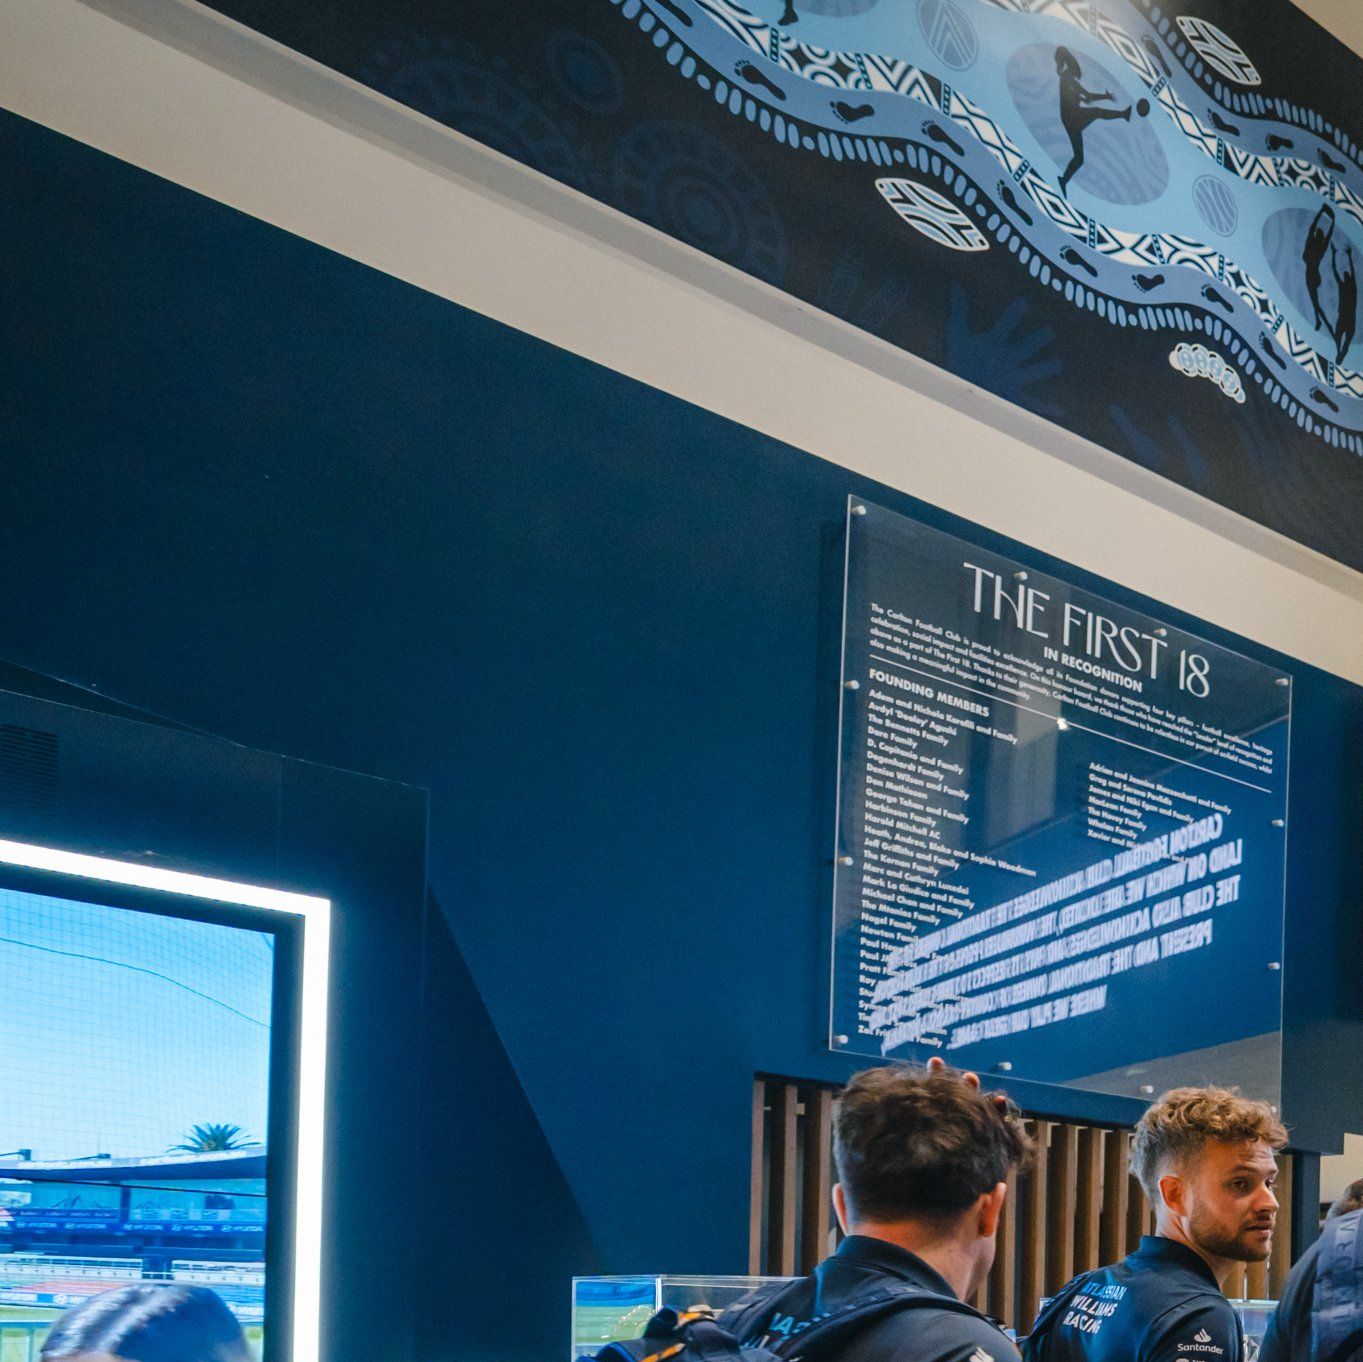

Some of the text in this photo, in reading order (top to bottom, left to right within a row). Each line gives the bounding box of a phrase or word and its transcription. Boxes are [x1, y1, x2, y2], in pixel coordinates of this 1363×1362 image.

[962, 561, 1210, 700] THE FIRST 18
[1043, 645, 1142, 693] IN RECOGNITION
[869, 668, 989, 717] FOUNDING MEMBERS
[868, 713, 883, 725] The
[922, 730, 948, 747] Family
[895, 696, 911, 709] and
[976, 723, 991, 735] and
[992, 728, 1017, 745] Family
[890, 732, 917, 750] Family
[867, 738, 876, 748] D.
[919, 753, 935, 766] and
[937, 759, 963, 776] Family
[896, 771, 924, 786] Wilson
[926, 779, 941, 792] and
[943, 785, 969, 801] Family
[864, 812, 940, 840] Harold Mitchell AC
[909, 812, 936, 828] Family
[1088, 806, 1100, 817] The
[1124, 817, 1146, 832] Family
[929, 841, 951, 855] Blake
[953, 848, 968, 859] and
[970, 852, 996, 868] Sophie
[862, 874, 885, 887] Mark
[887, 880, 899, 891] Lo
[931, 891, 946, 902] and
[948, 895, 974, 910] Family
[889, 918, 916, 933] Family
[1178, 1344, 1223, 1354] Santander
